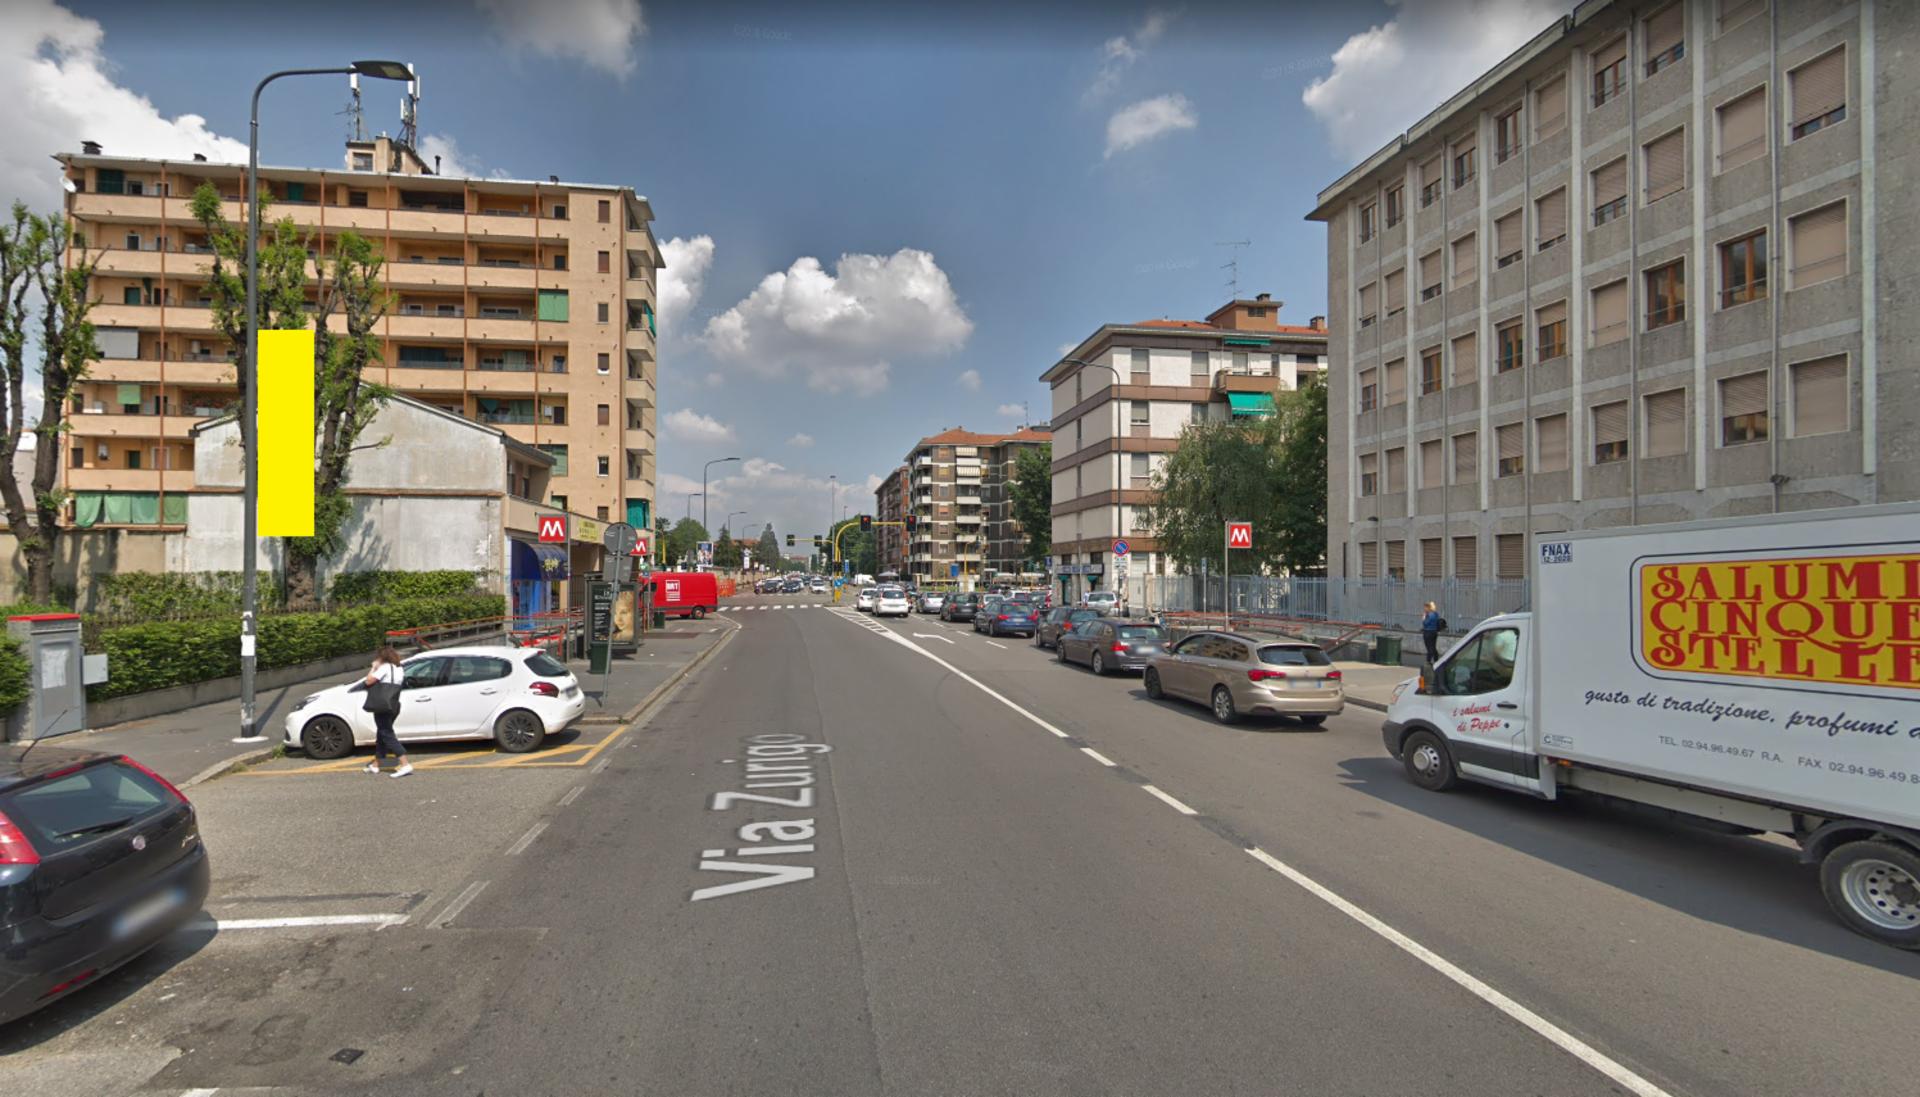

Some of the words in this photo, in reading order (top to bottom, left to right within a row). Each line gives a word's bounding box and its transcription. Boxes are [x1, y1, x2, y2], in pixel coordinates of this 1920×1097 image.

[541, 520, 564, 537] M
[1230, 527, 1249, 543] M
[1542, 543, 1571, 556] FNAX
[1650, 559, 1920, 601] SALUMI
[1650, 599, 1920, 650] CINQUE
[1650, 632, 1920, 684] STELLE
[1456, 720, 1468, 732] di
[1471, 717, 1502, 733] Peppe
[1460, 702, 1492, 716] salumi
[1584, 689, 1630, 705] gusto
[1636, 691, 1657, 708] di
[1785, 710, 1899, 737] profumi
[713, 733, 832, 810] Zurigo
[1798, 756, 1822, 769] FAX
[1828, 761, 1920, 785] 02.94.96.49.8
[690, 818, 815, 901] Via
